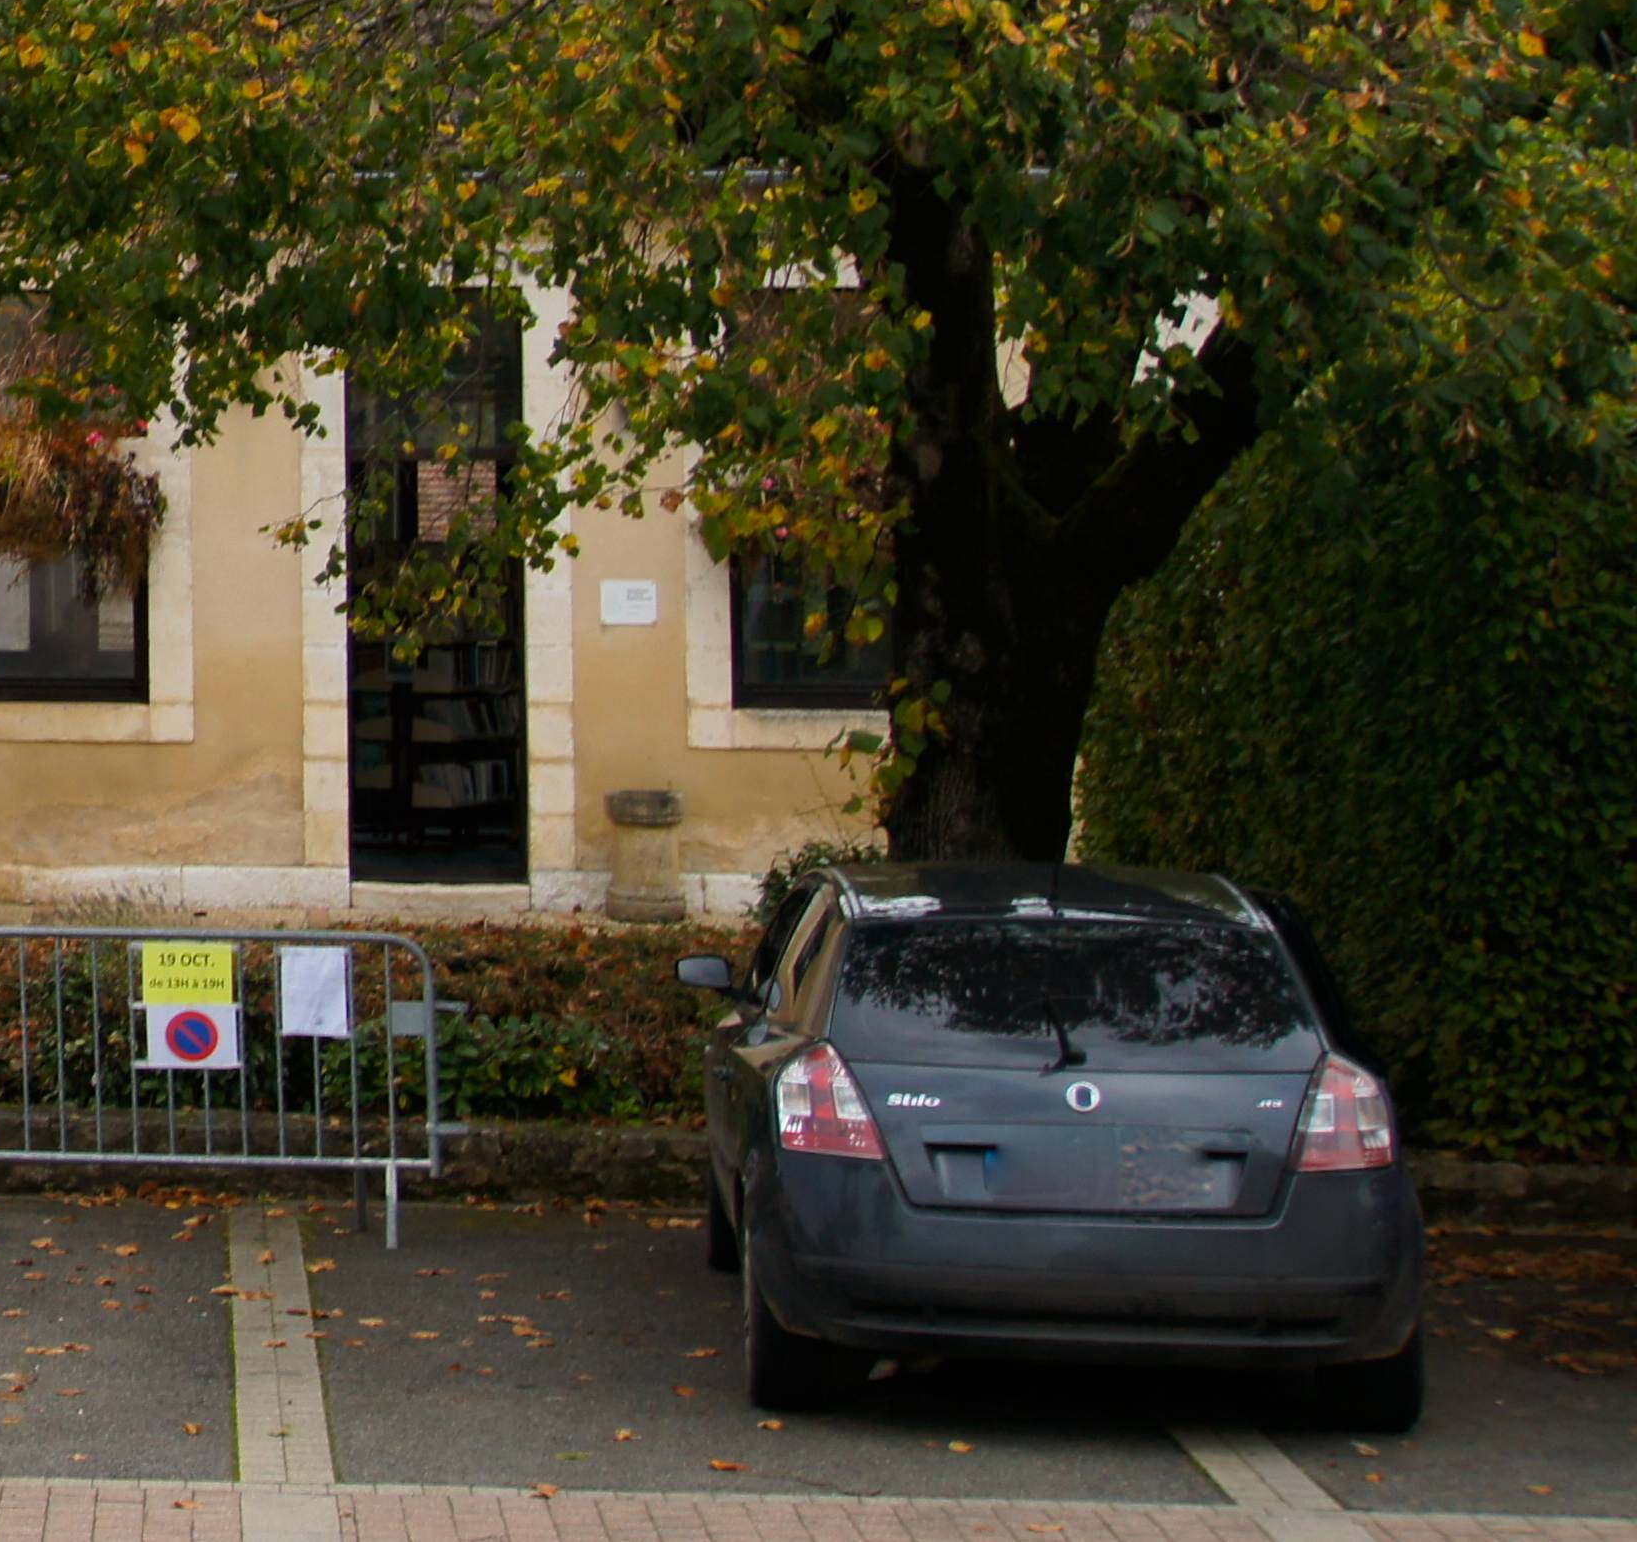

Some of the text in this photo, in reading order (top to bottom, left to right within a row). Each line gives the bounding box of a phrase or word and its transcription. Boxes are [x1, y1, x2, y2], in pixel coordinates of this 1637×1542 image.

[159, 953, 216, 967] 19 OCT.
[149, 978, 164, 989] de
[887, 1093, 940, 1107] Stilo
